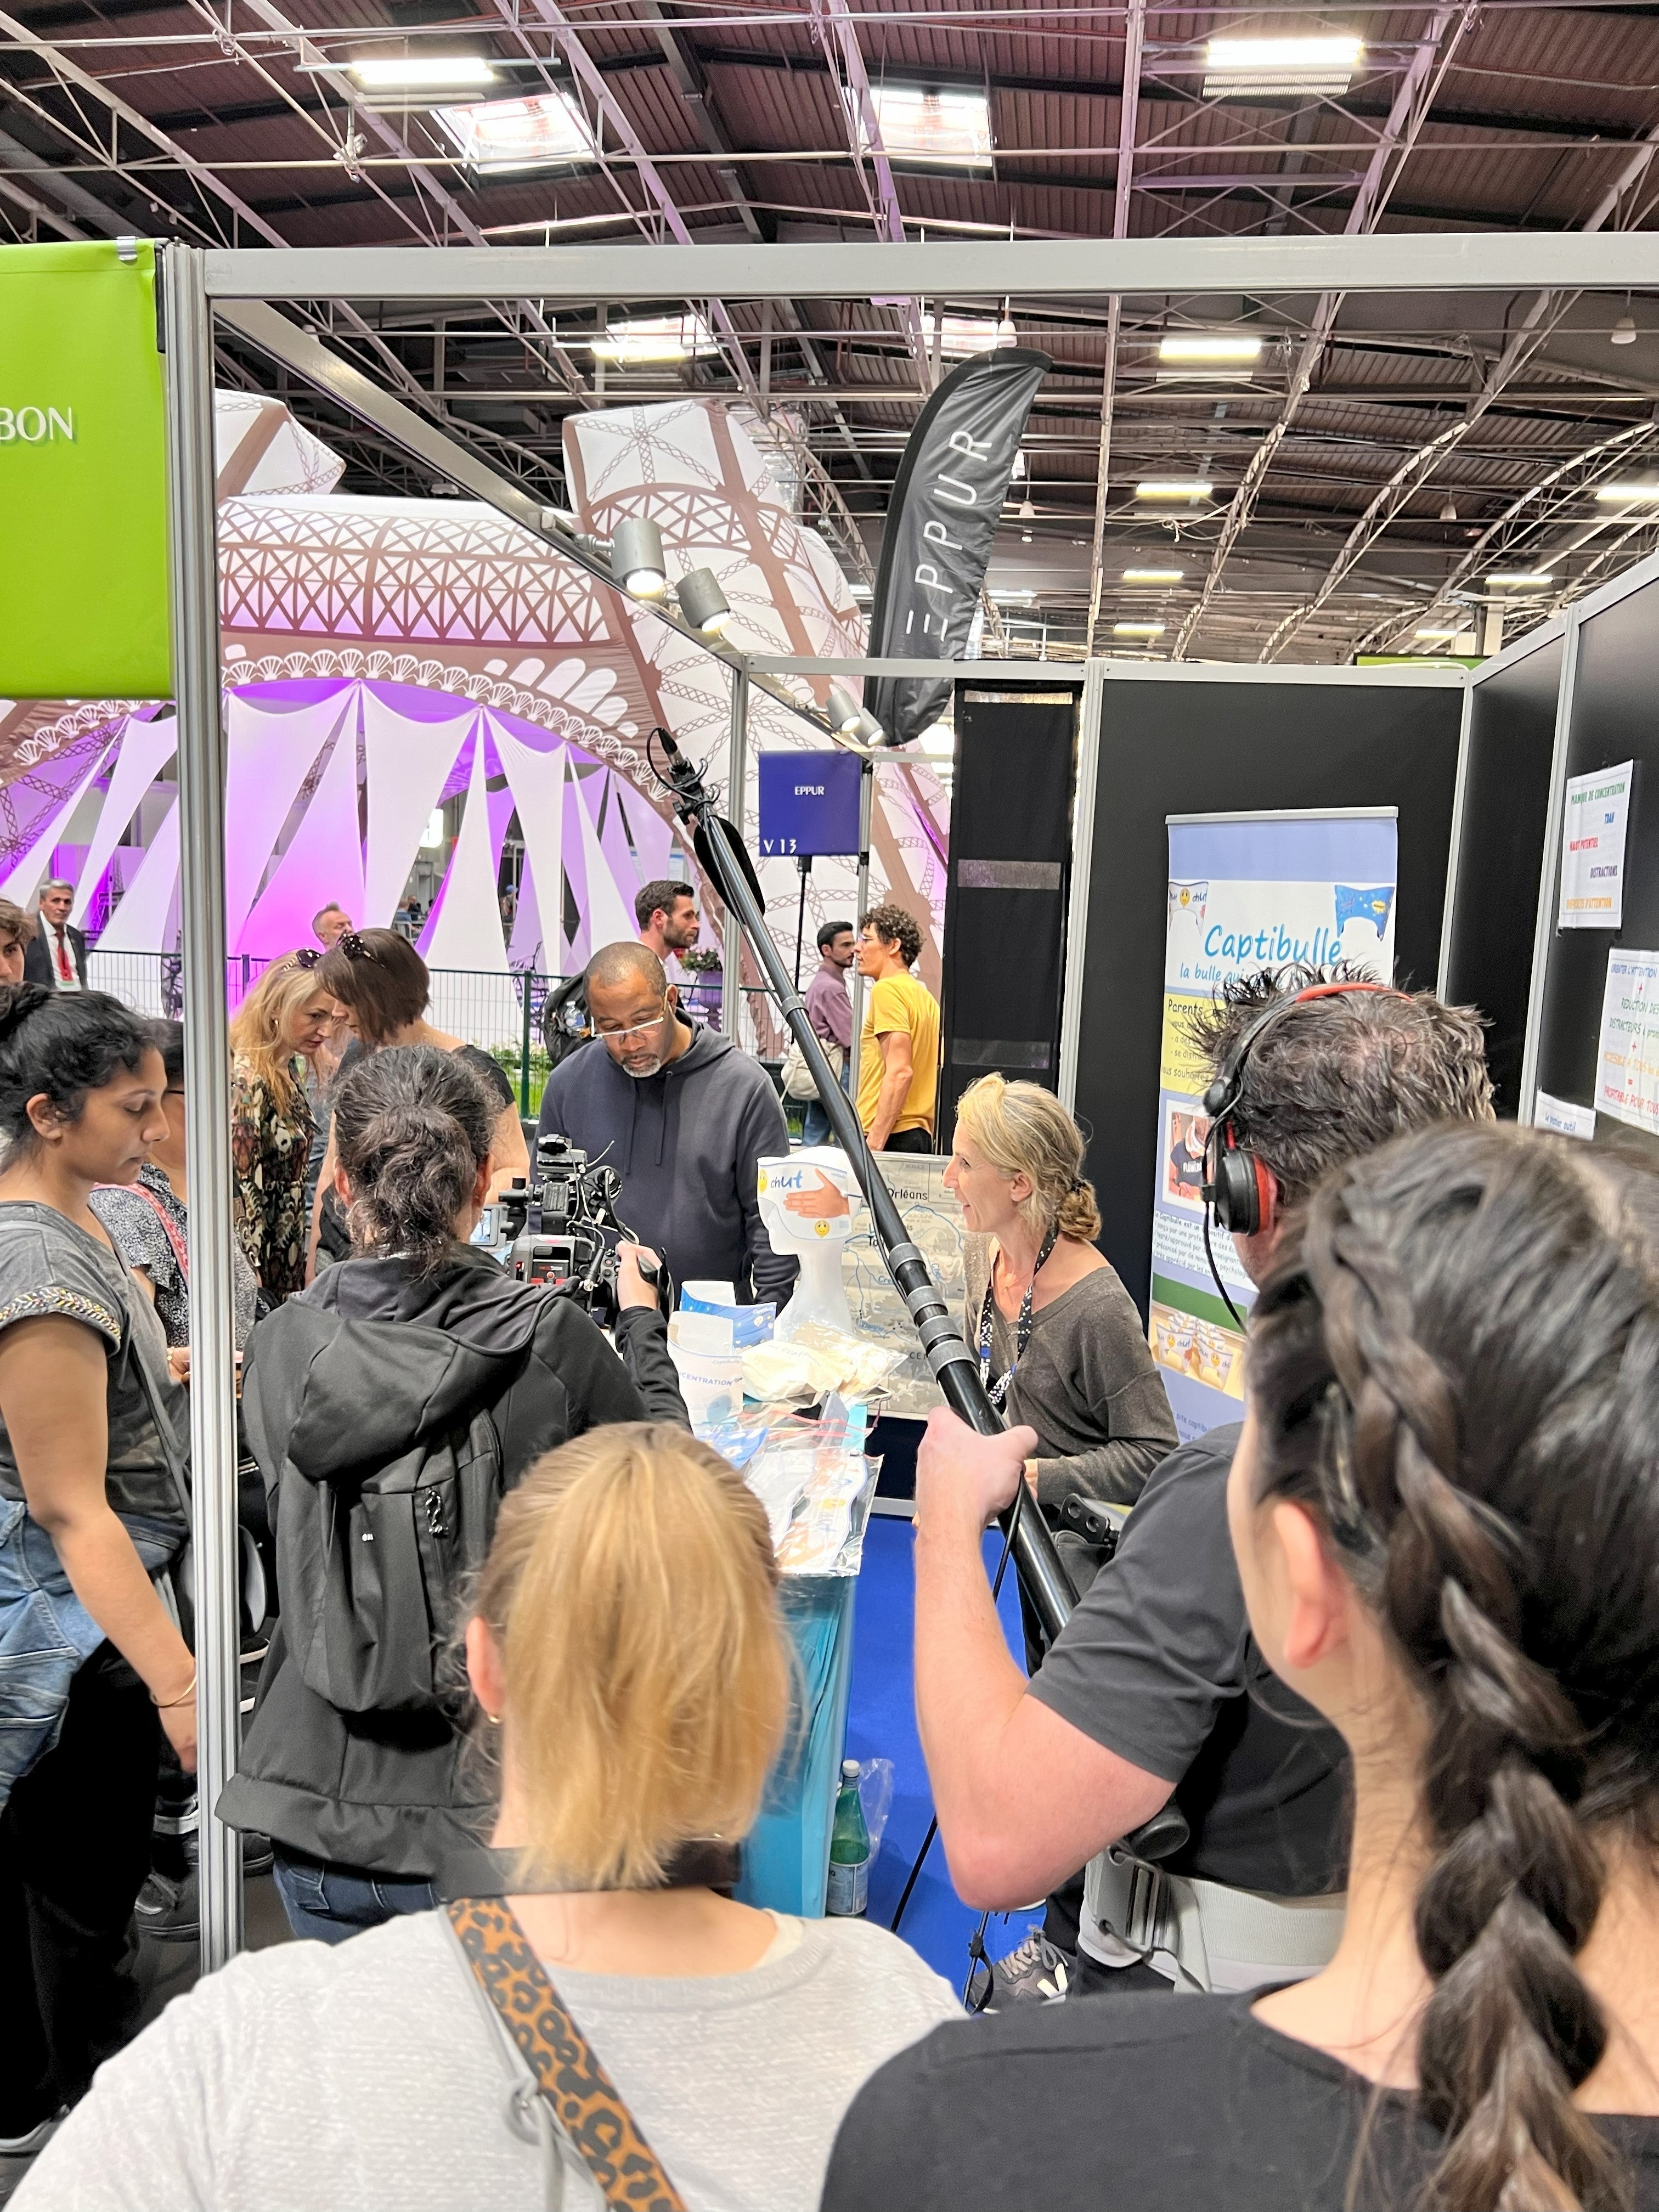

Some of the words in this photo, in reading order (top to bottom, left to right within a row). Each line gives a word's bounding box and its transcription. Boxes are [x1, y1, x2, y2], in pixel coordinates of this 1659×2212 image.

[0, 407, 73, 441] BON
[794, 786, 825, 795] EPPUR
[763, 839, 774, 854] V
[780, 838, 797, 854] 13
[1204, 924, 1342, 966] Captibulle
[1180, 963, 1189, 979] la
[1194, 963, 1221, 982] bulle
[1168, 998, 1203, 1015] Parents
[771, 1170, 803, 1188] chut
[679, 1371, 733, 1386] CENTRATION
